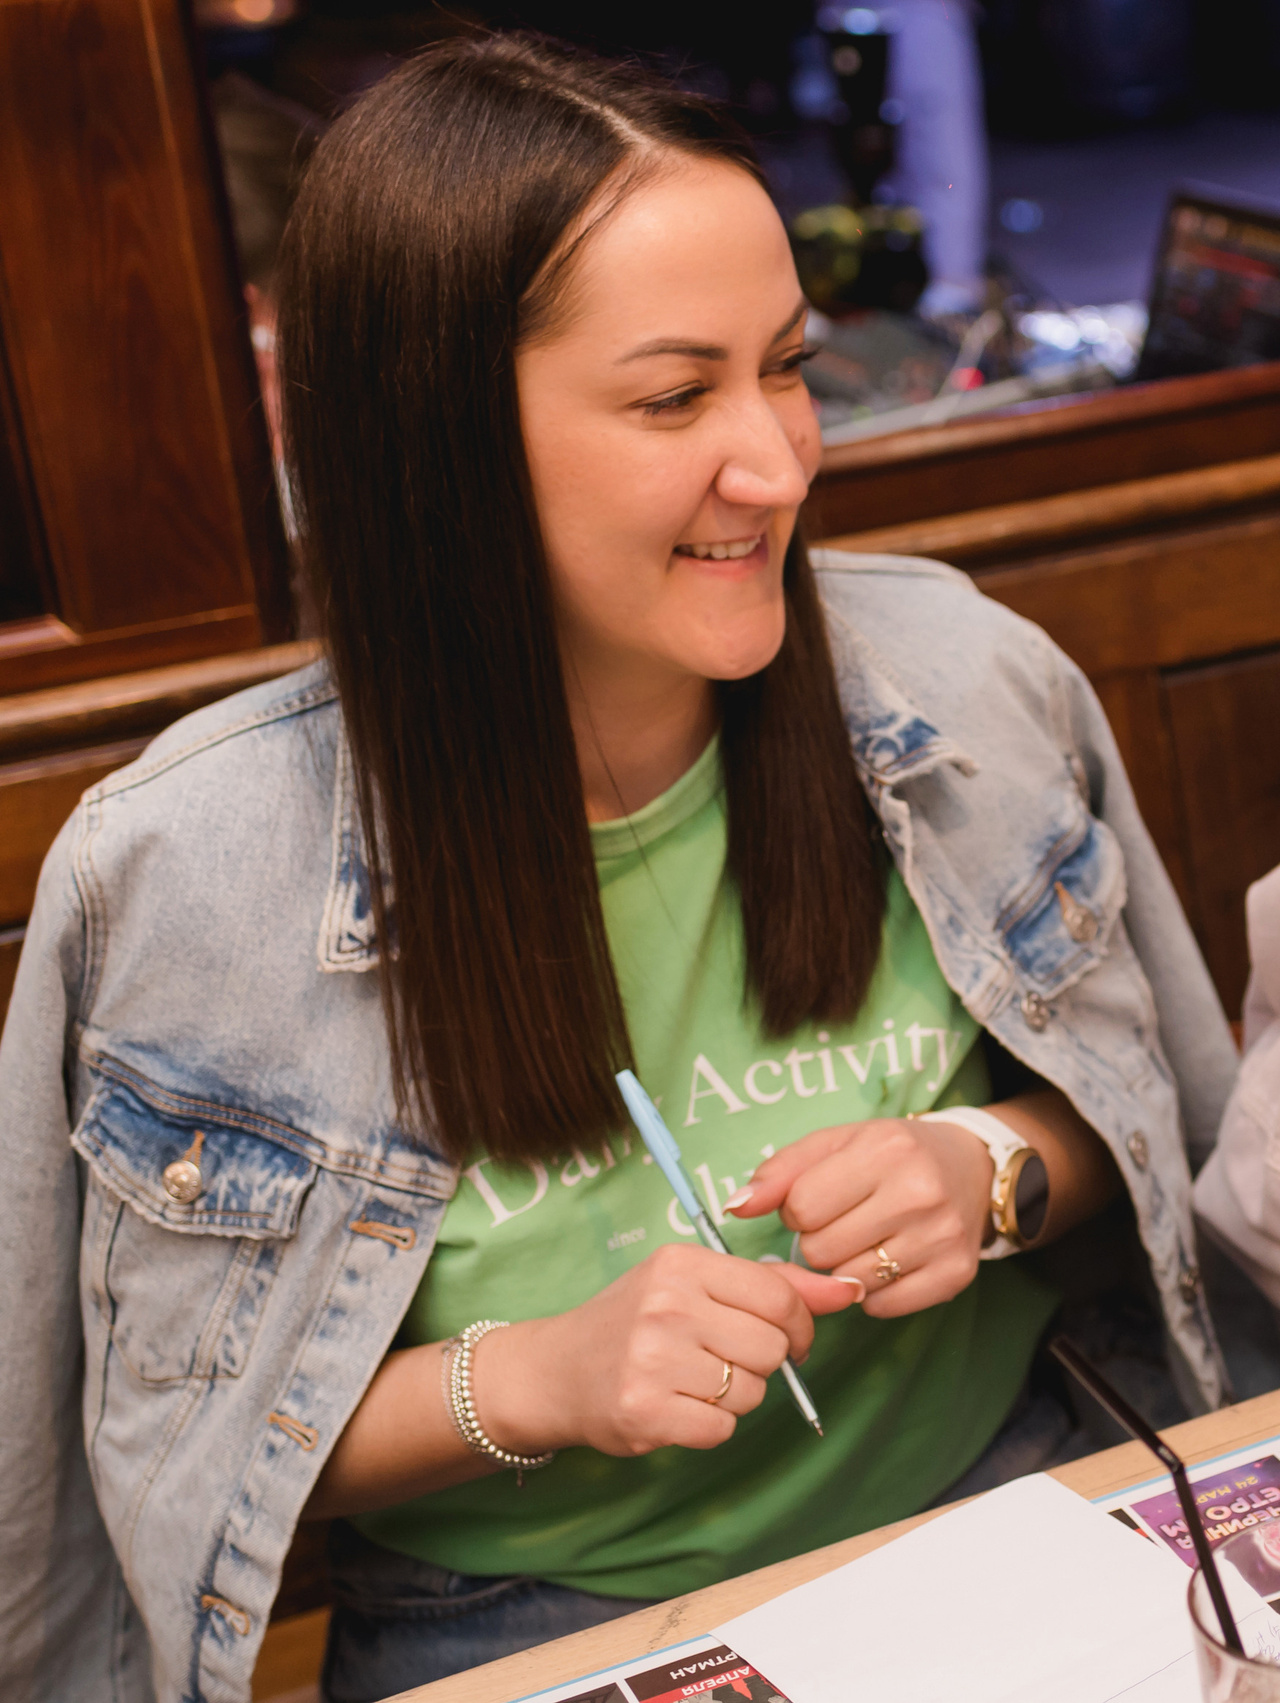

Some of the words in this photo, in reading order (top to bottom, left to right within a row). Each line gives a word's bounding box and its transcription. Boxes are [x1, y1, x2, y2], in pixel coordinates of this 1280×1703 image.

[683, 1020, 960, 1126] Activity
[607, 1227, 647, 1251] since
[1233, 1474, 1259, 1489] 24
[681, 1665, 751, 1697] АПРЕЛЯ
